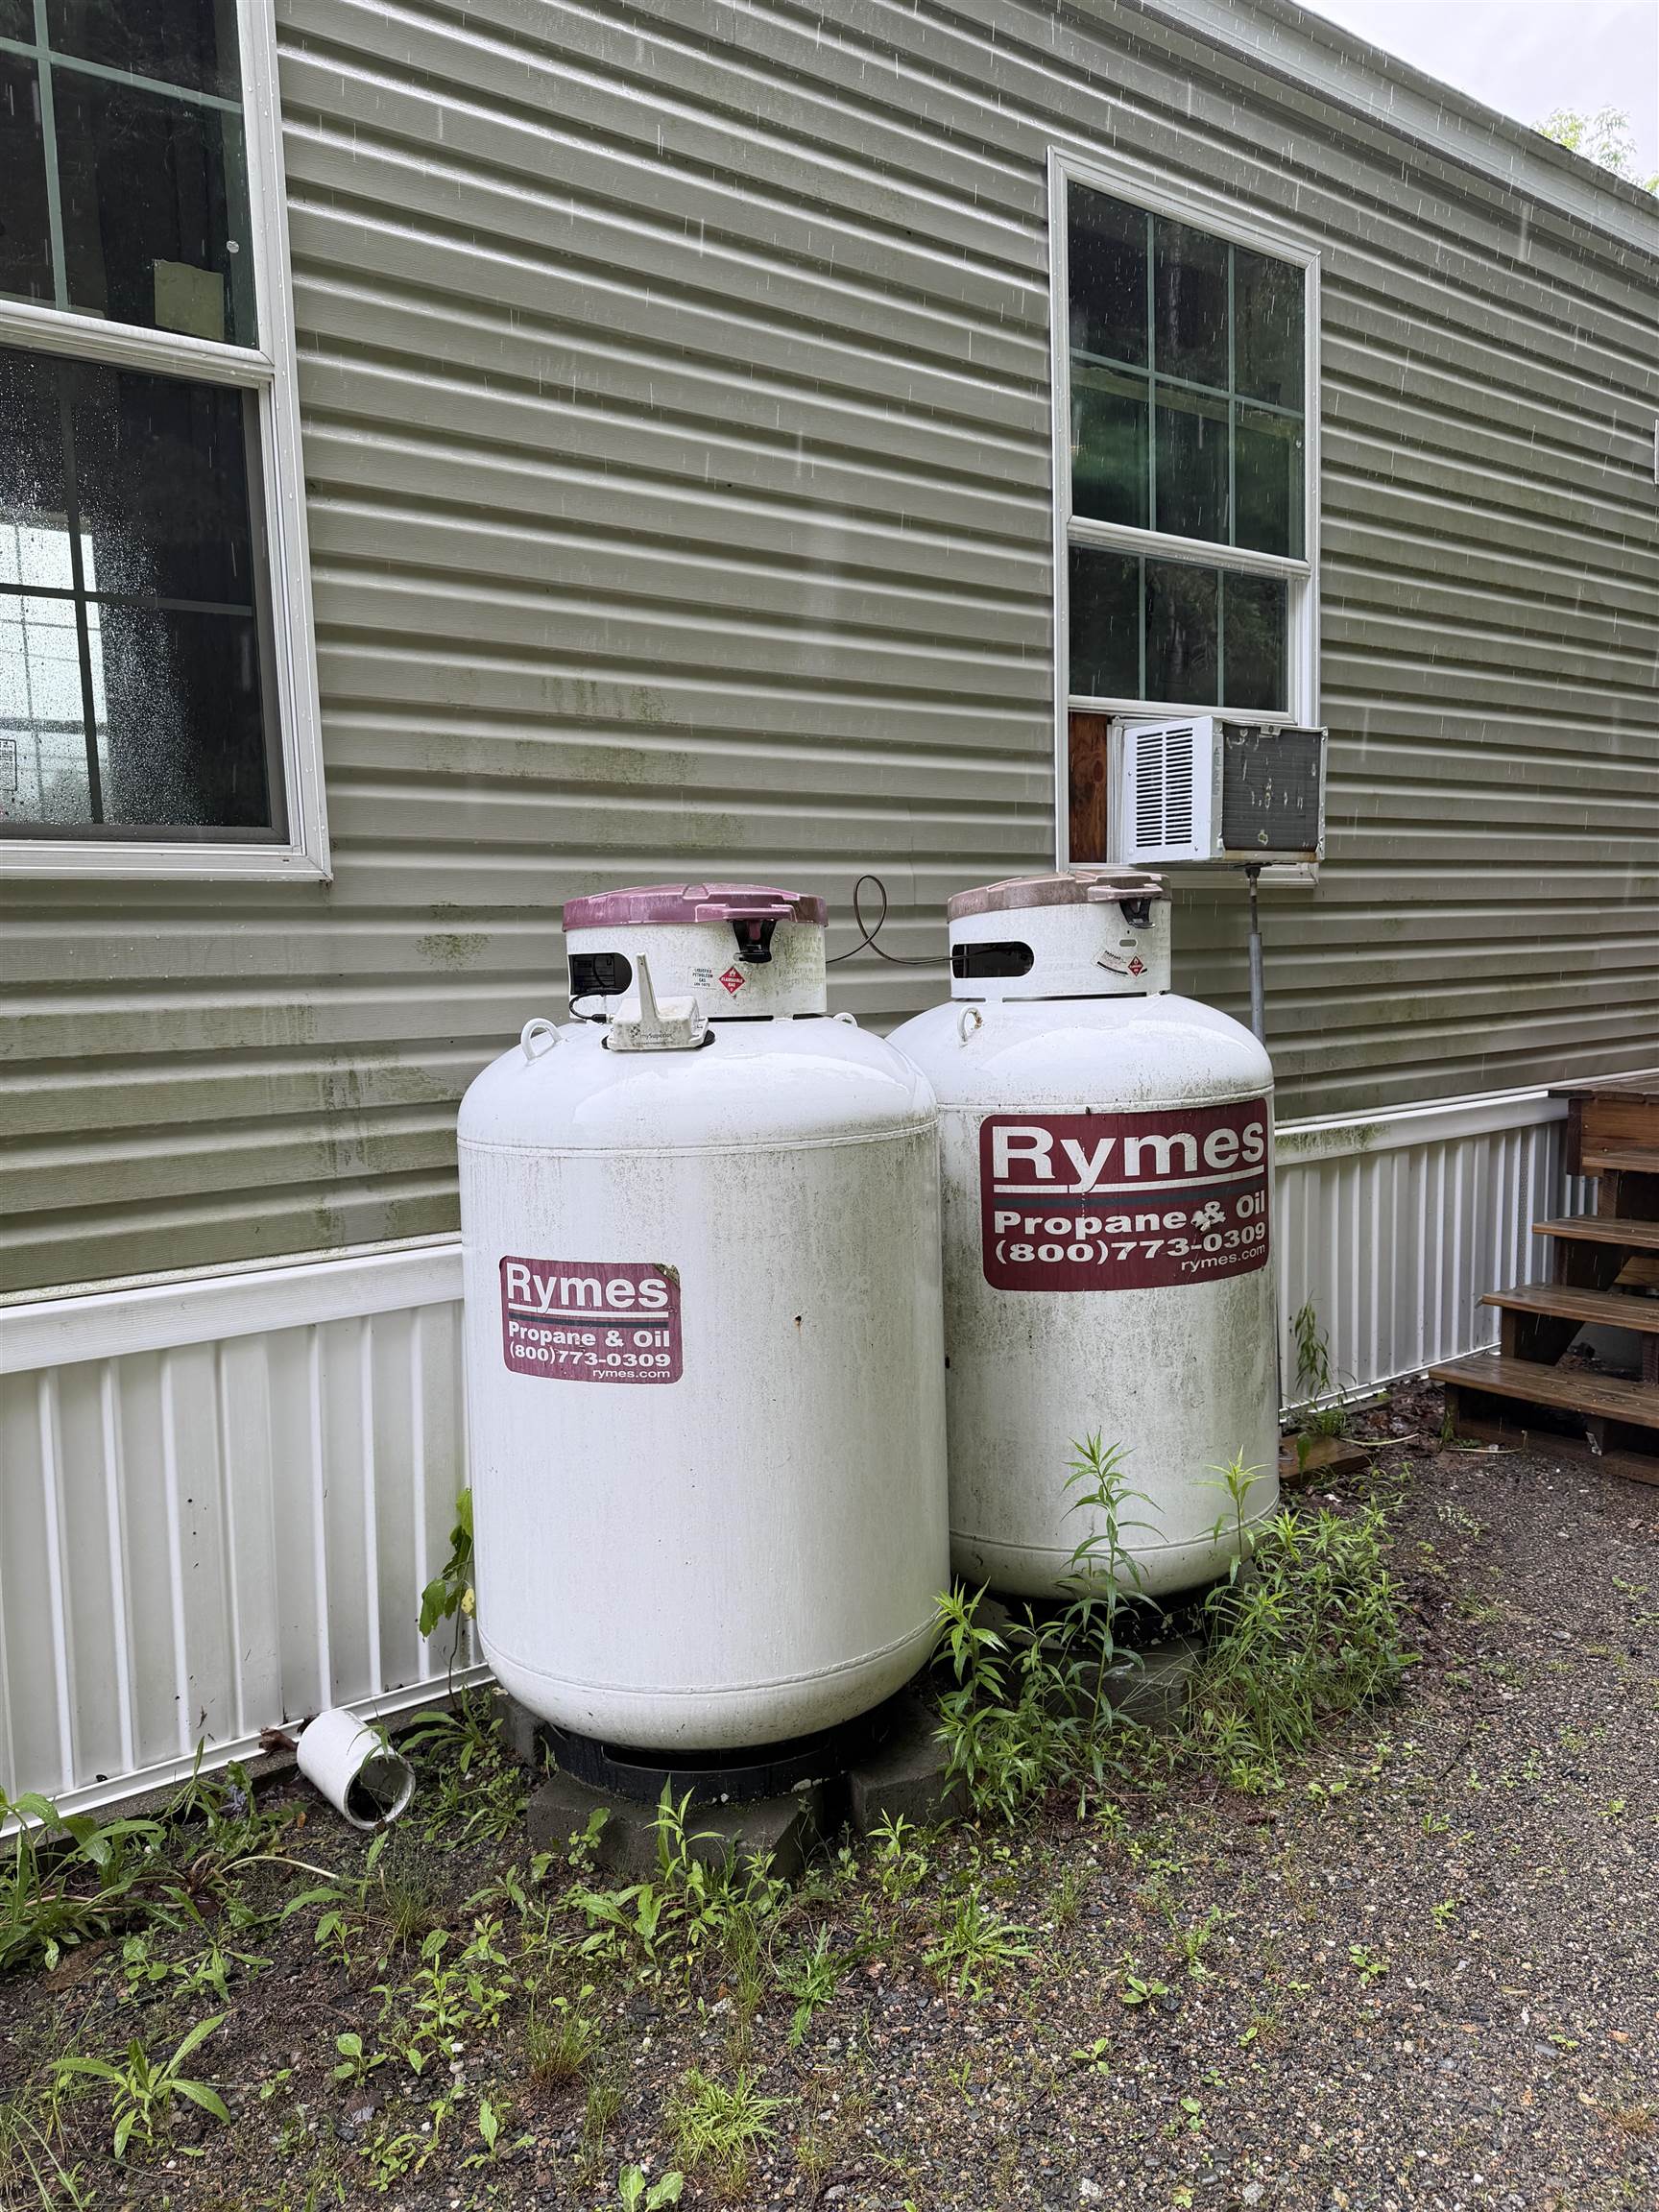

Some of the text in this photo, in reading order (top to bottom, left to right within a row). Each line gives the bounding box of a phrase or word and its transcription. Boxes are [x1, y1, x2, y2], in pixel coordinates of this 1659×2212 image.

[992, 1121, 1264, 1194] Rymes
[994, 1190, 1266, 1240] Propane & Oil
[995, 1221, 1266, 1265] (800)773-0309
[1181, 1244, 1266, 1272] rymes.com
[506, 1262, 669, 1313] Rymes
[508, 1321, 670, 1348] Propane & Oil
[510, 1341, 671, 1367] (800)773-0309
[592, 1369, 671, 1380] rymes.com
